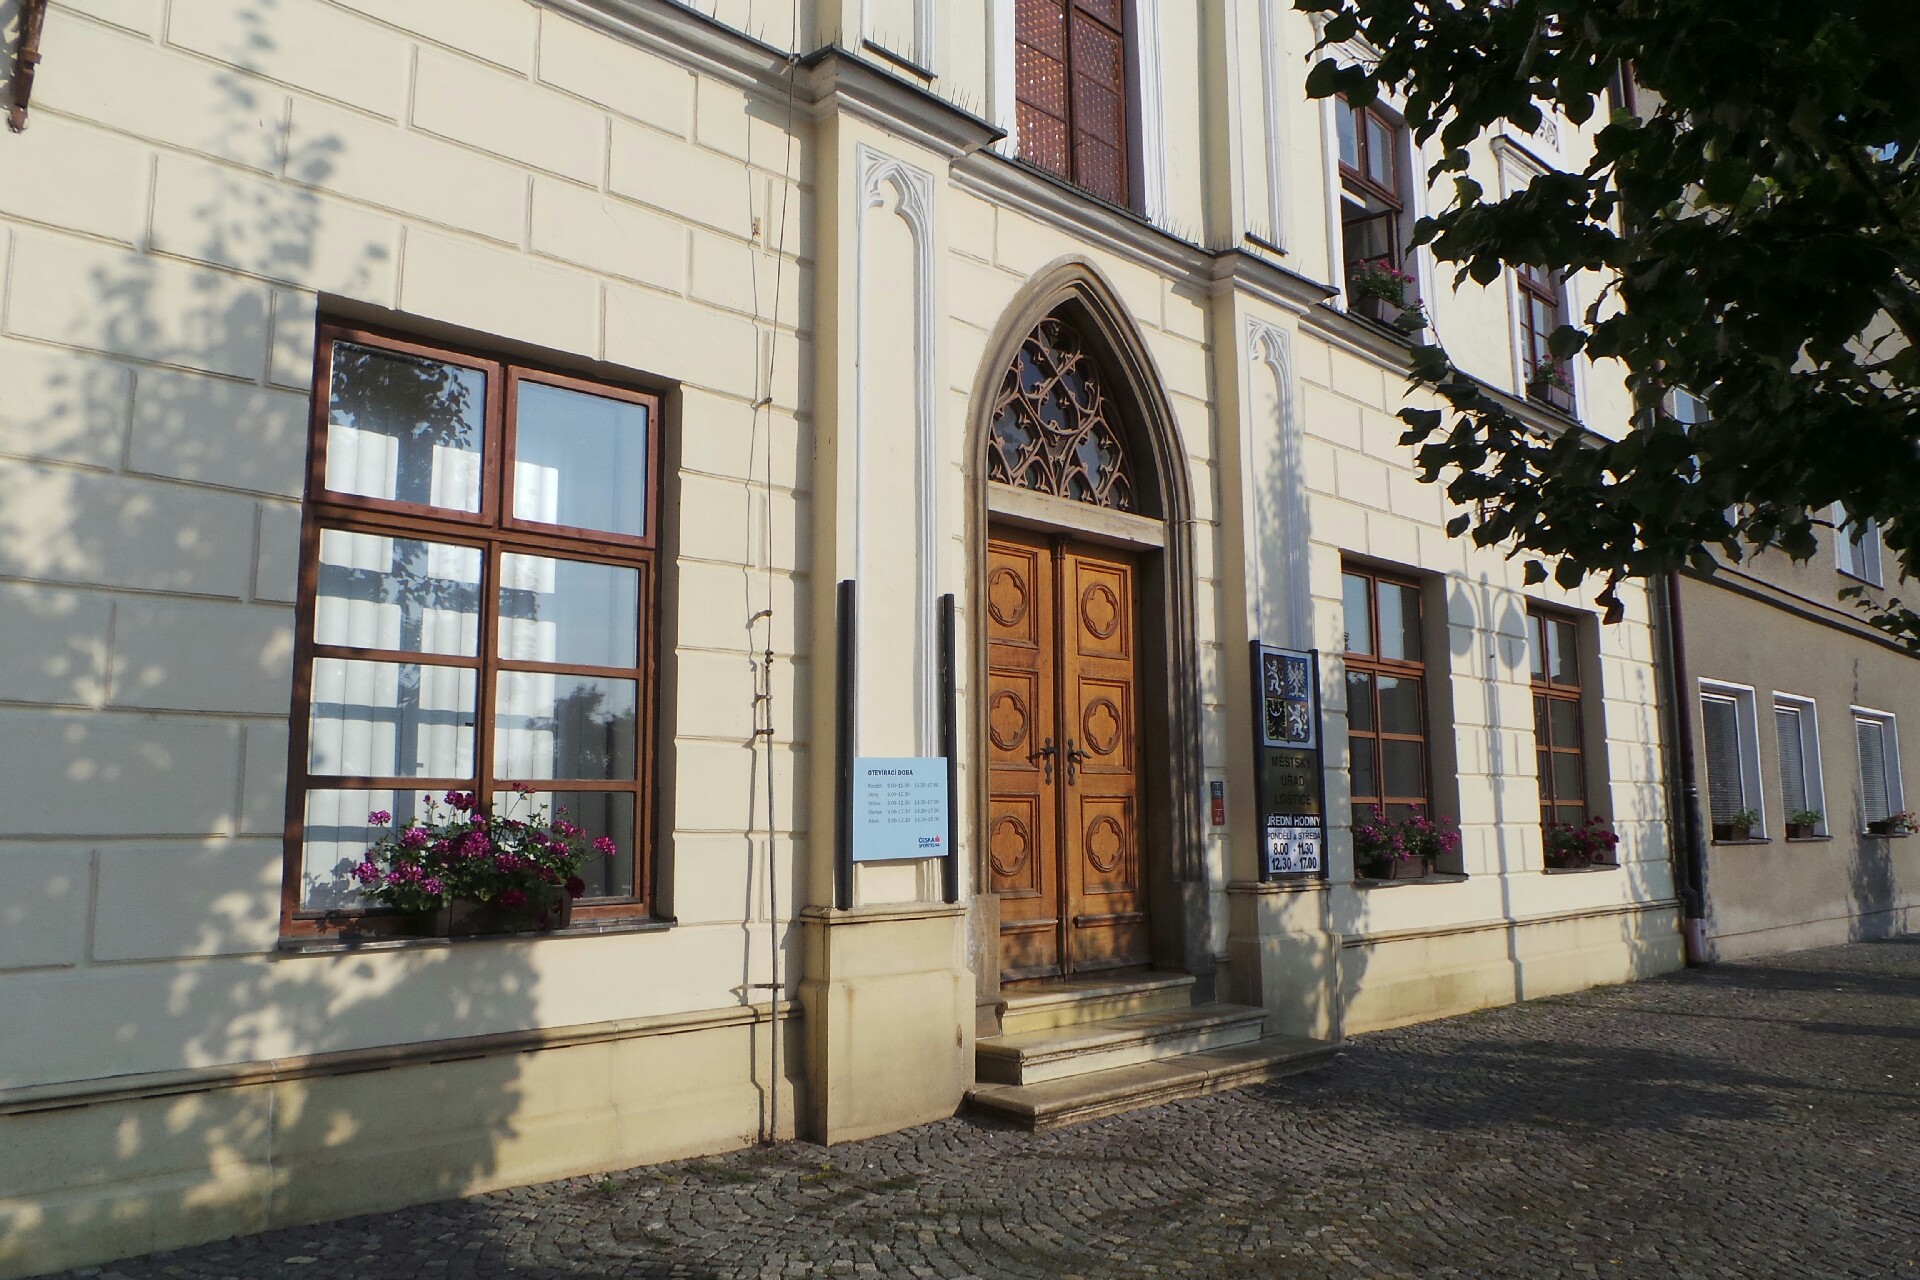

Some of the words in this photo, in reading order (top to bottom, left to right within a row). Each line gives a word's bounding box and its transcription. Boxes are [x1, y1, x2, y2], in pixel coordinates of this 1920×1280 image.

[868, 768, 897, 776] OTEVÍRACÍ
[1294, 815, 1321, 827] HODINY
[1273, 842, 1289, 855] 8.00
[1271, 857, 1292, 871] 12.30
[1300, 857, 1317, 870] 17.00
